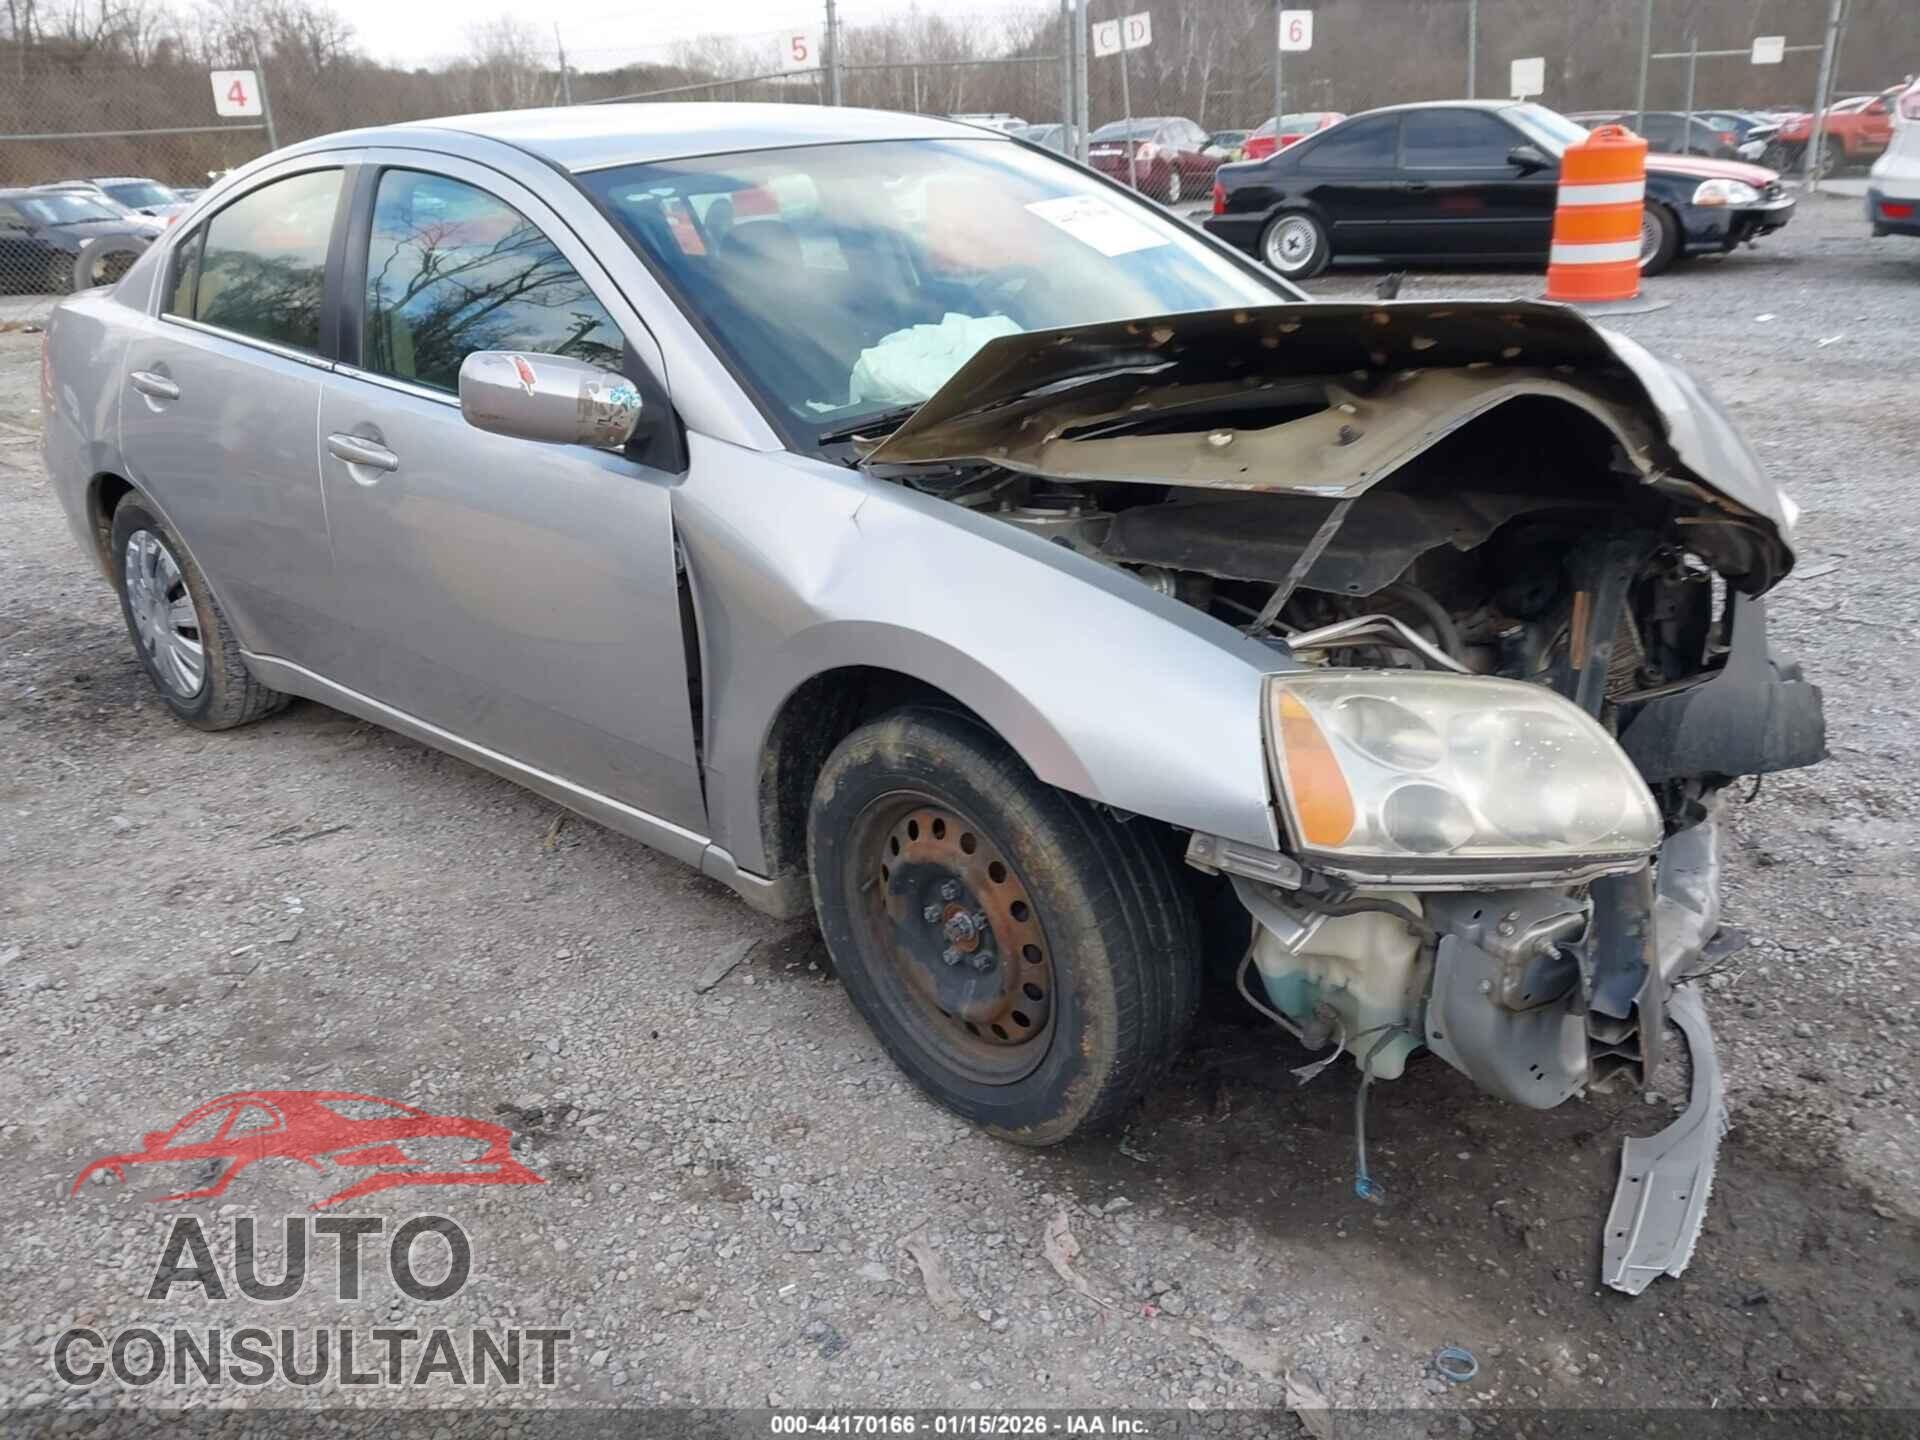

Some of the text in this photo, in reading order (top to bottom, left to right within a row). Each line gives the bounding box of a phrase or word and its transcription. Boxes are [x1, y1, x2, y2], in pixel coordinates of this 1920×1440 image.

[1130, 20, 1145, 41] D
[1290, 20, 1303, 42] 6
[792, 36, 807, 61] 5
[228, 80, 247, 107] 4
